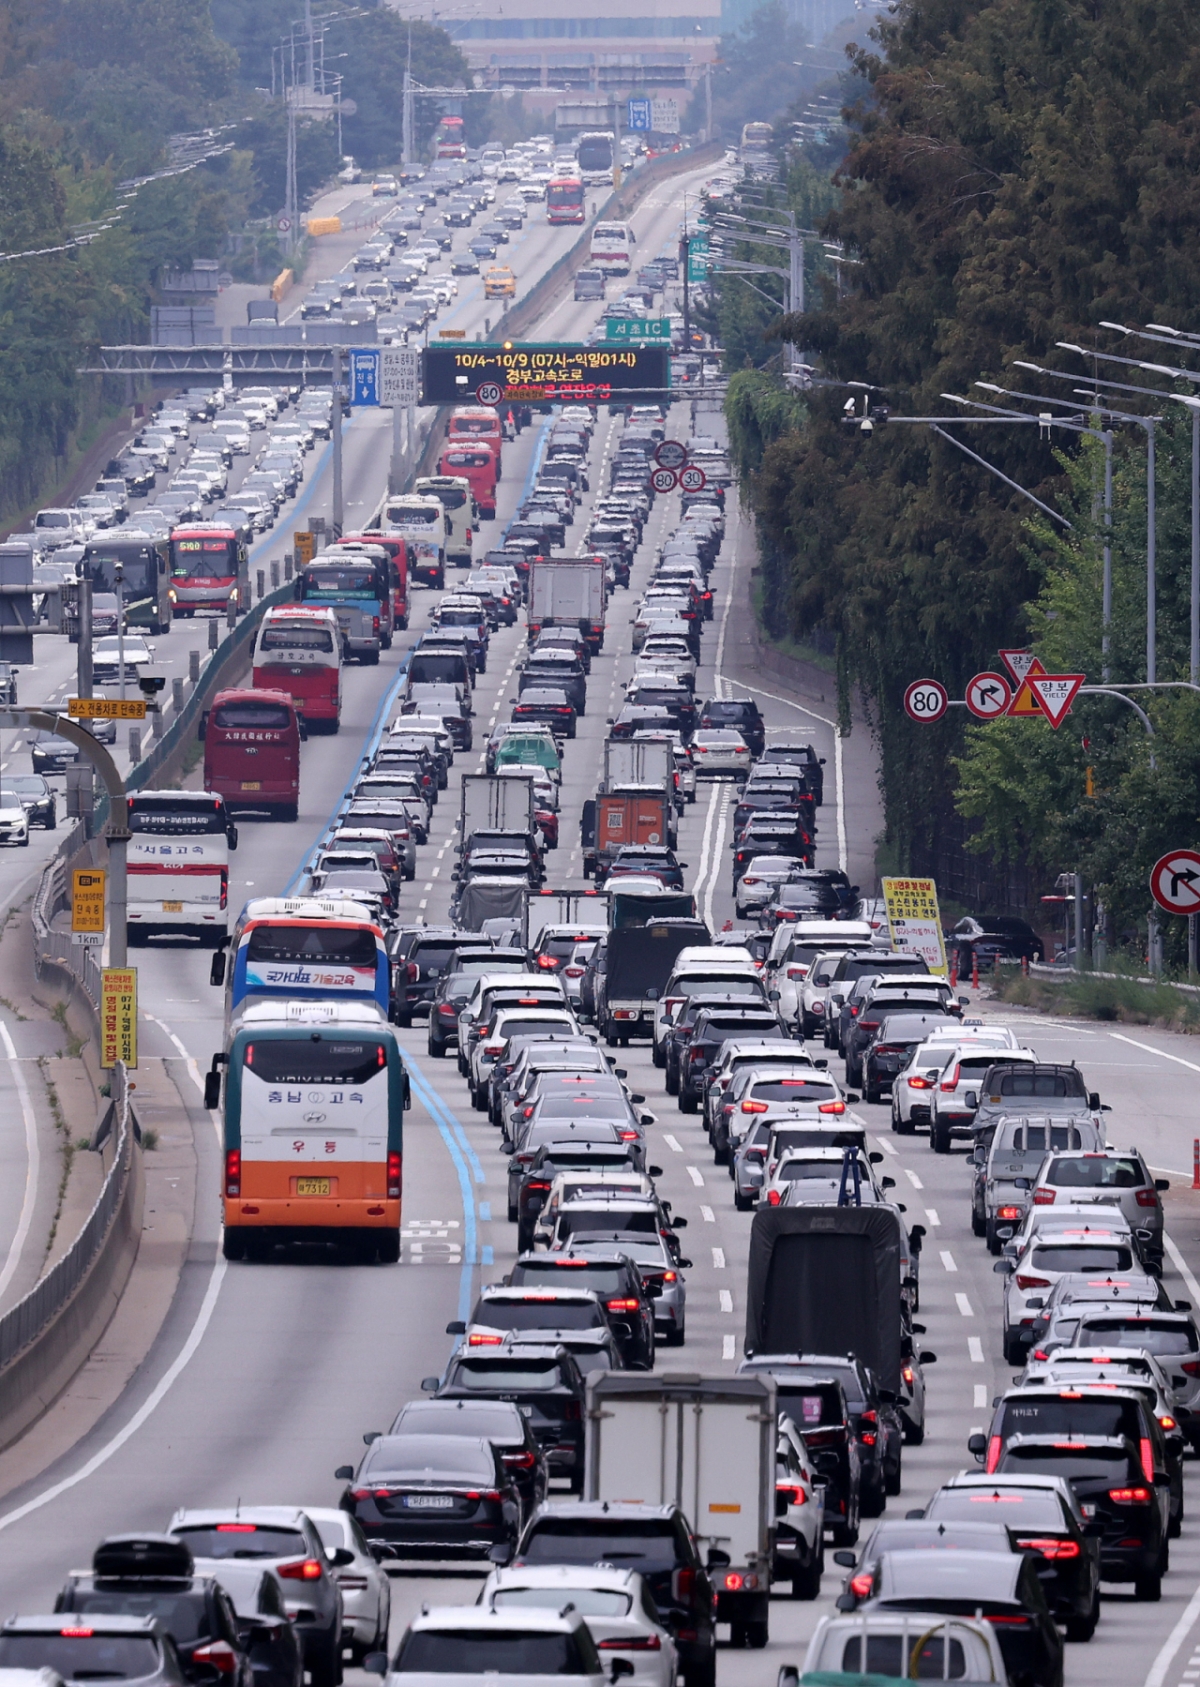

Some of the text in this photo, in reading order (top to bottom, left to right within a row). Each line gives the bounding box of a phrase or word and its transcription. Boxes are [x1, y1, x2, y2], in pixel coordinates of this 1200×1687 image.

[455, 354, 528, 368] 10/4~10/9
[506, 369, 583, 384] 경부고속도로
[482, 387, 498, 400] 80
[656, 474, 672, 487] 80
[685, 472, 700, 484] 30
[1041, 682, 1068, 692] 양보
[913, 691, 939, 711] 80
[70, 702, 143, 716] 버스 전용차로 단속중
[77, 935, 98, 944] 1km
[267, 971, 356, 986] 국가대표 기술교육
[268, 1091, 363, 1104] 충남 고속
[292, 1140, 337, 1154] 우등
